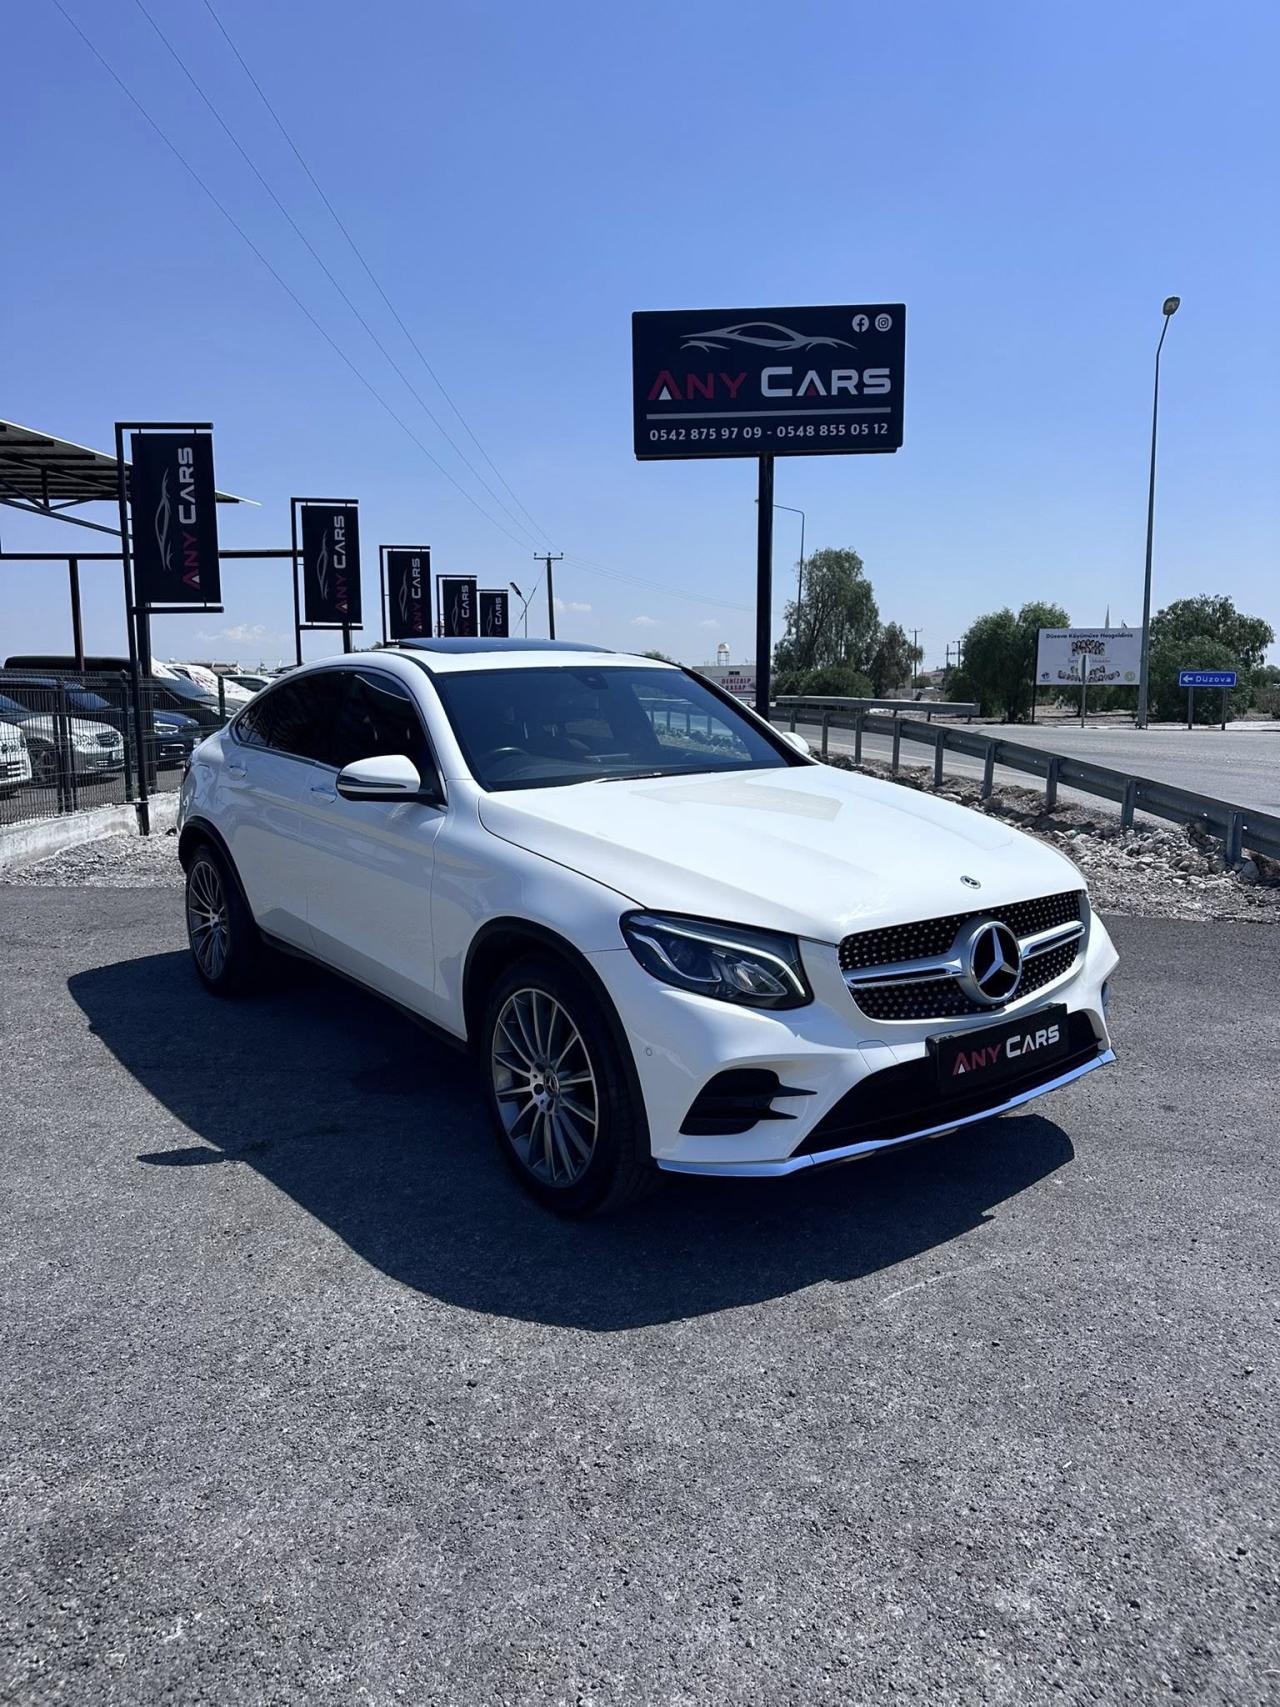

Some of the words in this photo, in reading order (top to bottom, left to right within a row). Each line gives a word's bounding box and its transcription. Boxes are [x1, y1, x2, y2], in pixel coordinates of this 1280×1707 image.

[648, 370, 748, 401] ANY
[760, 366, 892, 397] CARS
[649, 429, 686, 441] 0542
[690, 428, 717, 440] 875
[720, 427, 738, 439] 97
[743, 426, 762, 438] 09
[776, 425, 815, 438] 0548
[819, 424, 846, 436] 855
[850, 423, 869, 435] 05
[873, 423, 888, 434] 12
[177, 447, 197, 524] CARS
[182, 531, 201, 590] ANY
[333, 515, 347, 569] CARS
[335, 573, 349, 614] ANY
[411, 558, 422, 599] CARS
[411, 602, 423, 633] ANY
[461, 585, 470, 618] CARS
[495, 597, 503, 625] CARS
[1195, 674, 1232, 683] Düzova
[952, 1043, 1002, 1076] ANY
[1005, 1024, 1060, 1058] CARS
